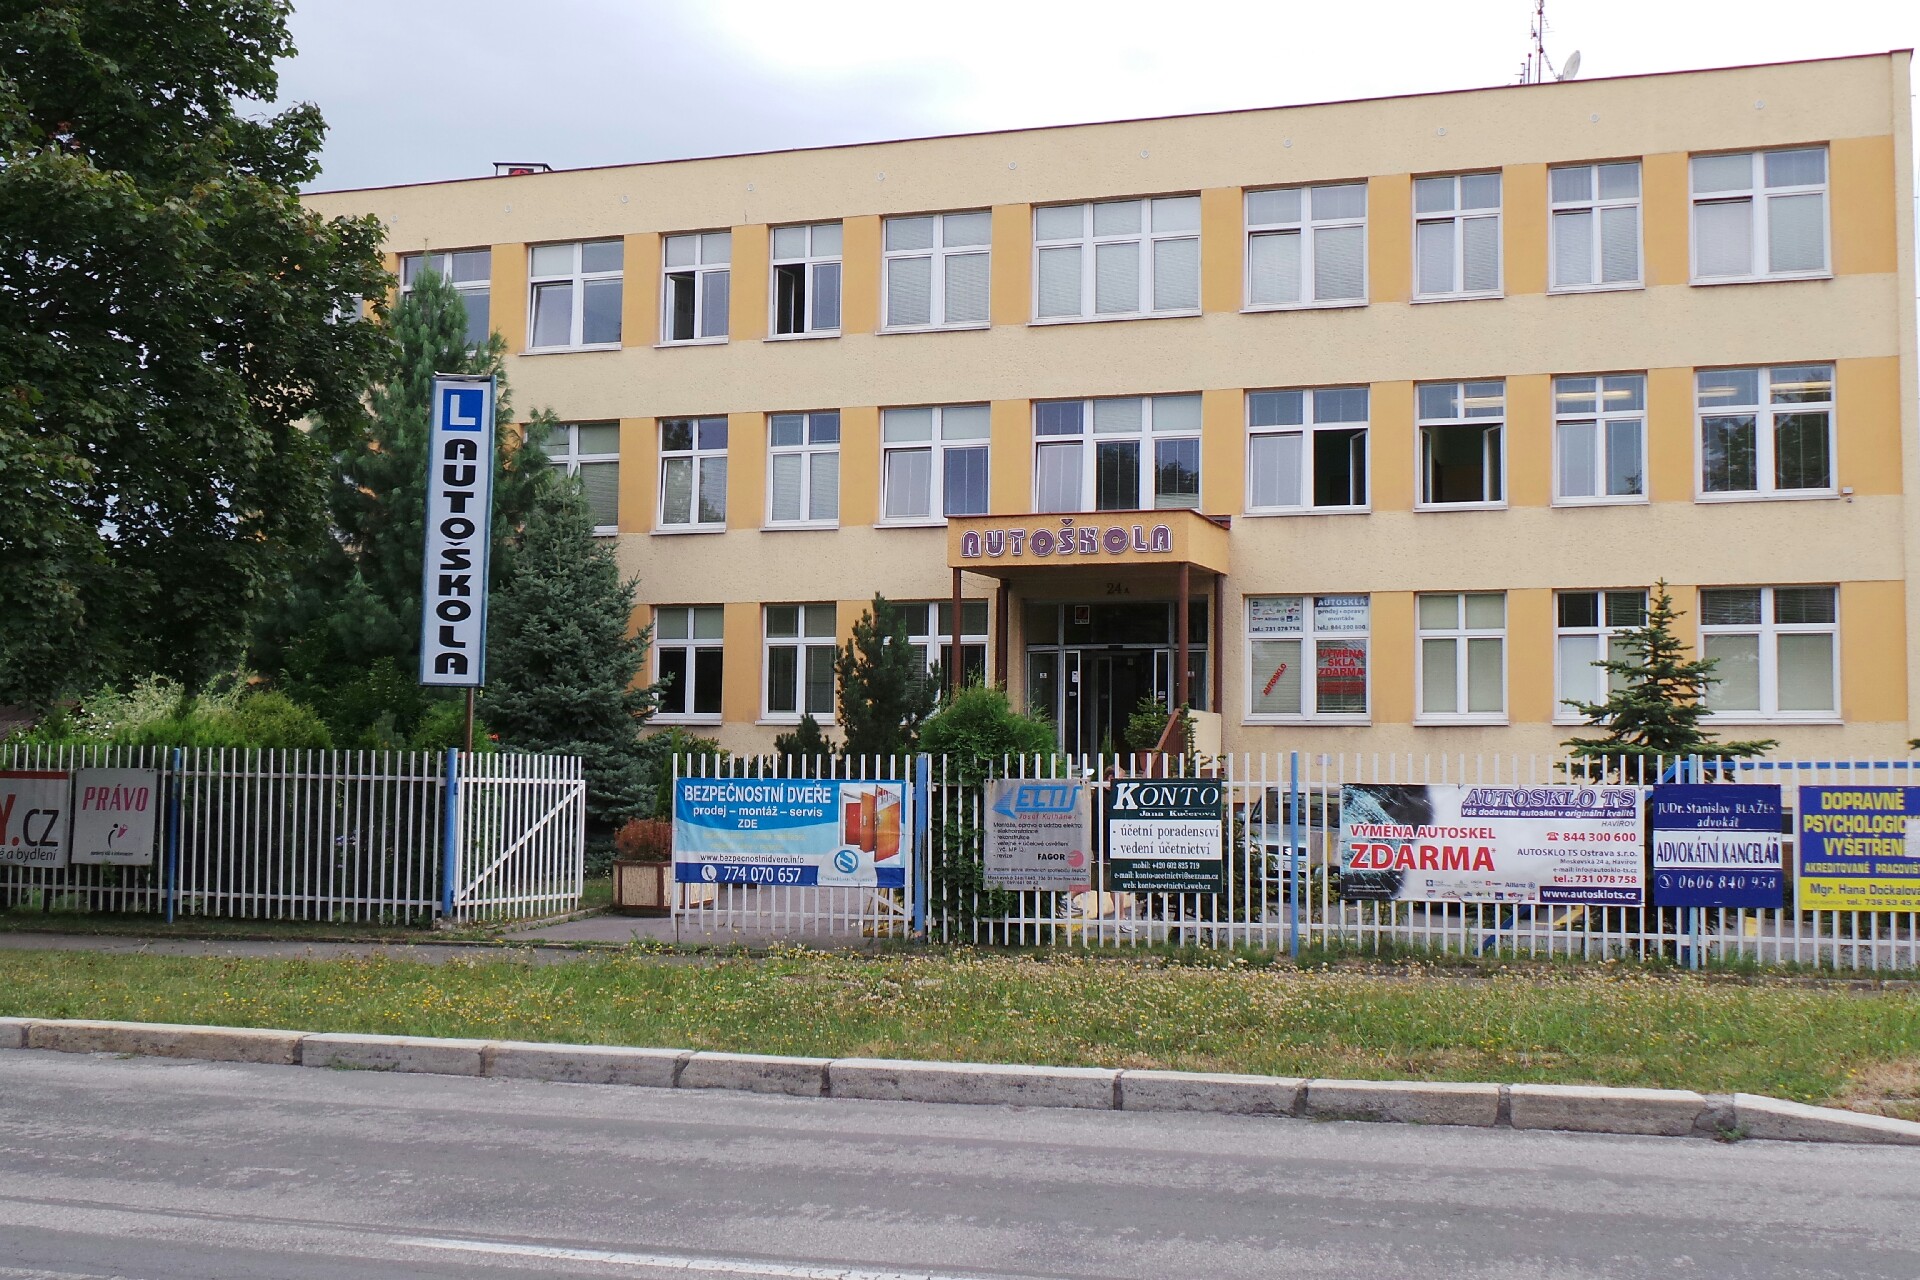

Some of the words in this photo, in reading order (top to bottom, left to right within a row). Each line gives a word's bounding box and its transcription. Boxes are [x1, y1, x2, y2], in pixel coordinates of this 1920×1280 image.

[961, 518, 1173, 558] AUTOŠKOLA
[434, 438, 478, 675] AUTOŠKOLA
[1106, 582, 1121, 594] 24
[1328, 658, 1356, 667] SKLA
[1318, 667, 1365, 677] ZDARMA
[1263, 663, 1287, 696] AUTOSKLO
[82, 784, 149, 812] PRÁVO
[684, 783, 784, 803] BEZPEČNOSTNÍ
[787, 784, 832, 804] DVEŘE
[1113, 782, 1219, 810] KONTO
[1462, 789, 1596, 807] AUTOSKLO
[1600, 789, 1636, 807] TS
[693, 805, 727, 818] prodej
[739, 806, 778, 816] montáž
[790, 807, 823, 817] servis
[1169, 809, 1216, 817] Kučerová
[1462, 807, 1477, 815] Váš
[1478, 807, 1519, 816] dodavatel
[1520, 809, 1556, 817] autoskel
[1565, 809, 1605, 819] originální
[1606, 809, 1635, 818] kvalitě
[1658, 802, 1685, 814] JUDr.
[1686, 802, 1730, 814] Stanislav
[737, 819, 758, 829] ZDE
[1697, 815, 1739, 828] advokát
[1803, 815, 1920, 834] PSYCHOLOGIC
[1121, 823, 1153, 837] účetní
[1350, 823, 1413, 837] VÝMĚNA
[1417, 826, 1496, 839] AUTOSKEL
[1563, 833, 1585, 841] 844
[1589, 833, 1611, 841] 300
[1614, 833, 1636, 842] 600
[1121, 841, 1154, 854] vedení
[1159, 841, 1210, 855] účetnictví
[1517, 848, 1565, 856] AUTOSKLO
[1568, 849, 1578, 857] TS
[1580, 849, 1614, 857] Ostrava
[1656, 836, 1719, 863] ADVOKÁTNÍ
[1722, 837, 1779, 863] KANCELÁŘ
[16, 847, 58, 864] bydlení
[1038, 853, 1066, 861] FAGOR
[1132, 861, 1151, 869] mobil:
[1152, 861, 1166, 869] +420
[1804, 861, 1870, 874] AKREDITOVANÉ
[723, 866, 747, 881] 774
[750, 867, 774, 882] 070
[778, 868, 801, 883] 657
[1597, 875, 1615, 883] 078
[1123, 881, 1136, 889] web:
[1678, 875, 1714, 889] 0606
[1542, 889, 1636, 899] www.autosklots.cz
[1810, 883, 1835, 896] Mgr.
[1839, 884, 1865, 894] Hana
